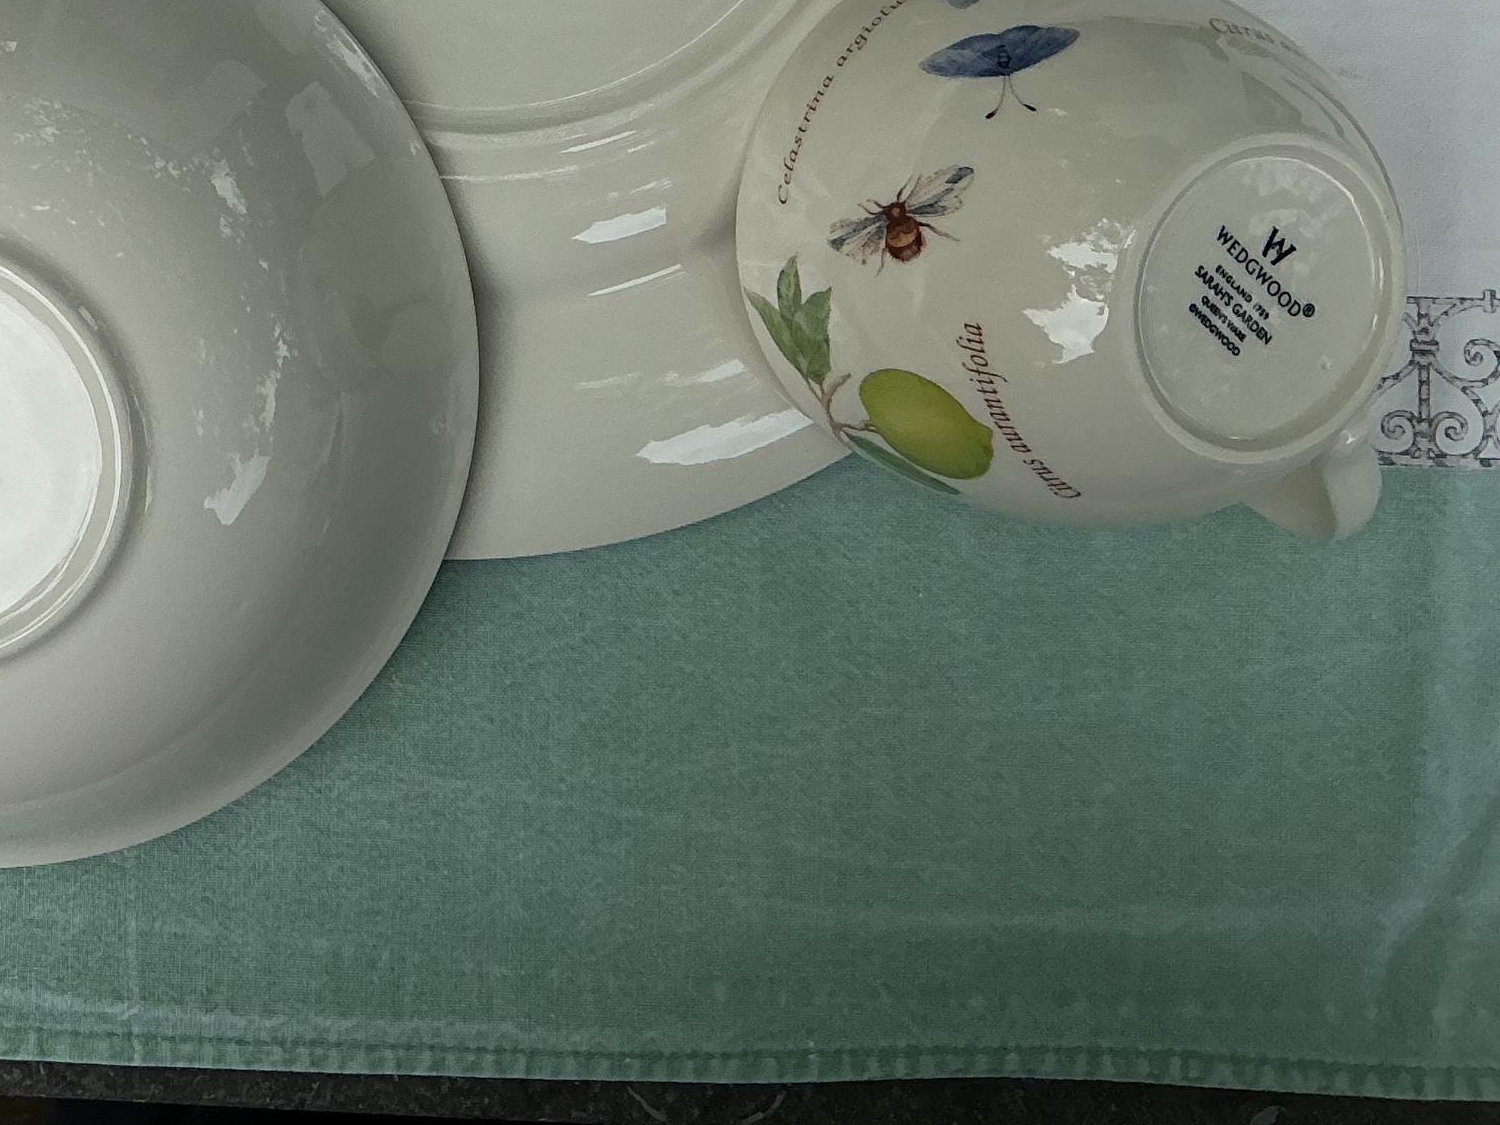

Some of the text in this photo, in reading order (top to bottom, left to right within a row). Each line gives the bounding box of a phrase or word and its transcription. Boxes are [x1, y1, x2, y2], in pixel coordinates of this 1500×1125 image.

[1194, 265, 1273, 346] SARAH'S GARDEN
[1215, 264, 1253, 303] ENGLAND
[1227, 319, 1247, 343] WARE
[955, 322, 1082, 499] Citrus aurantifolia
